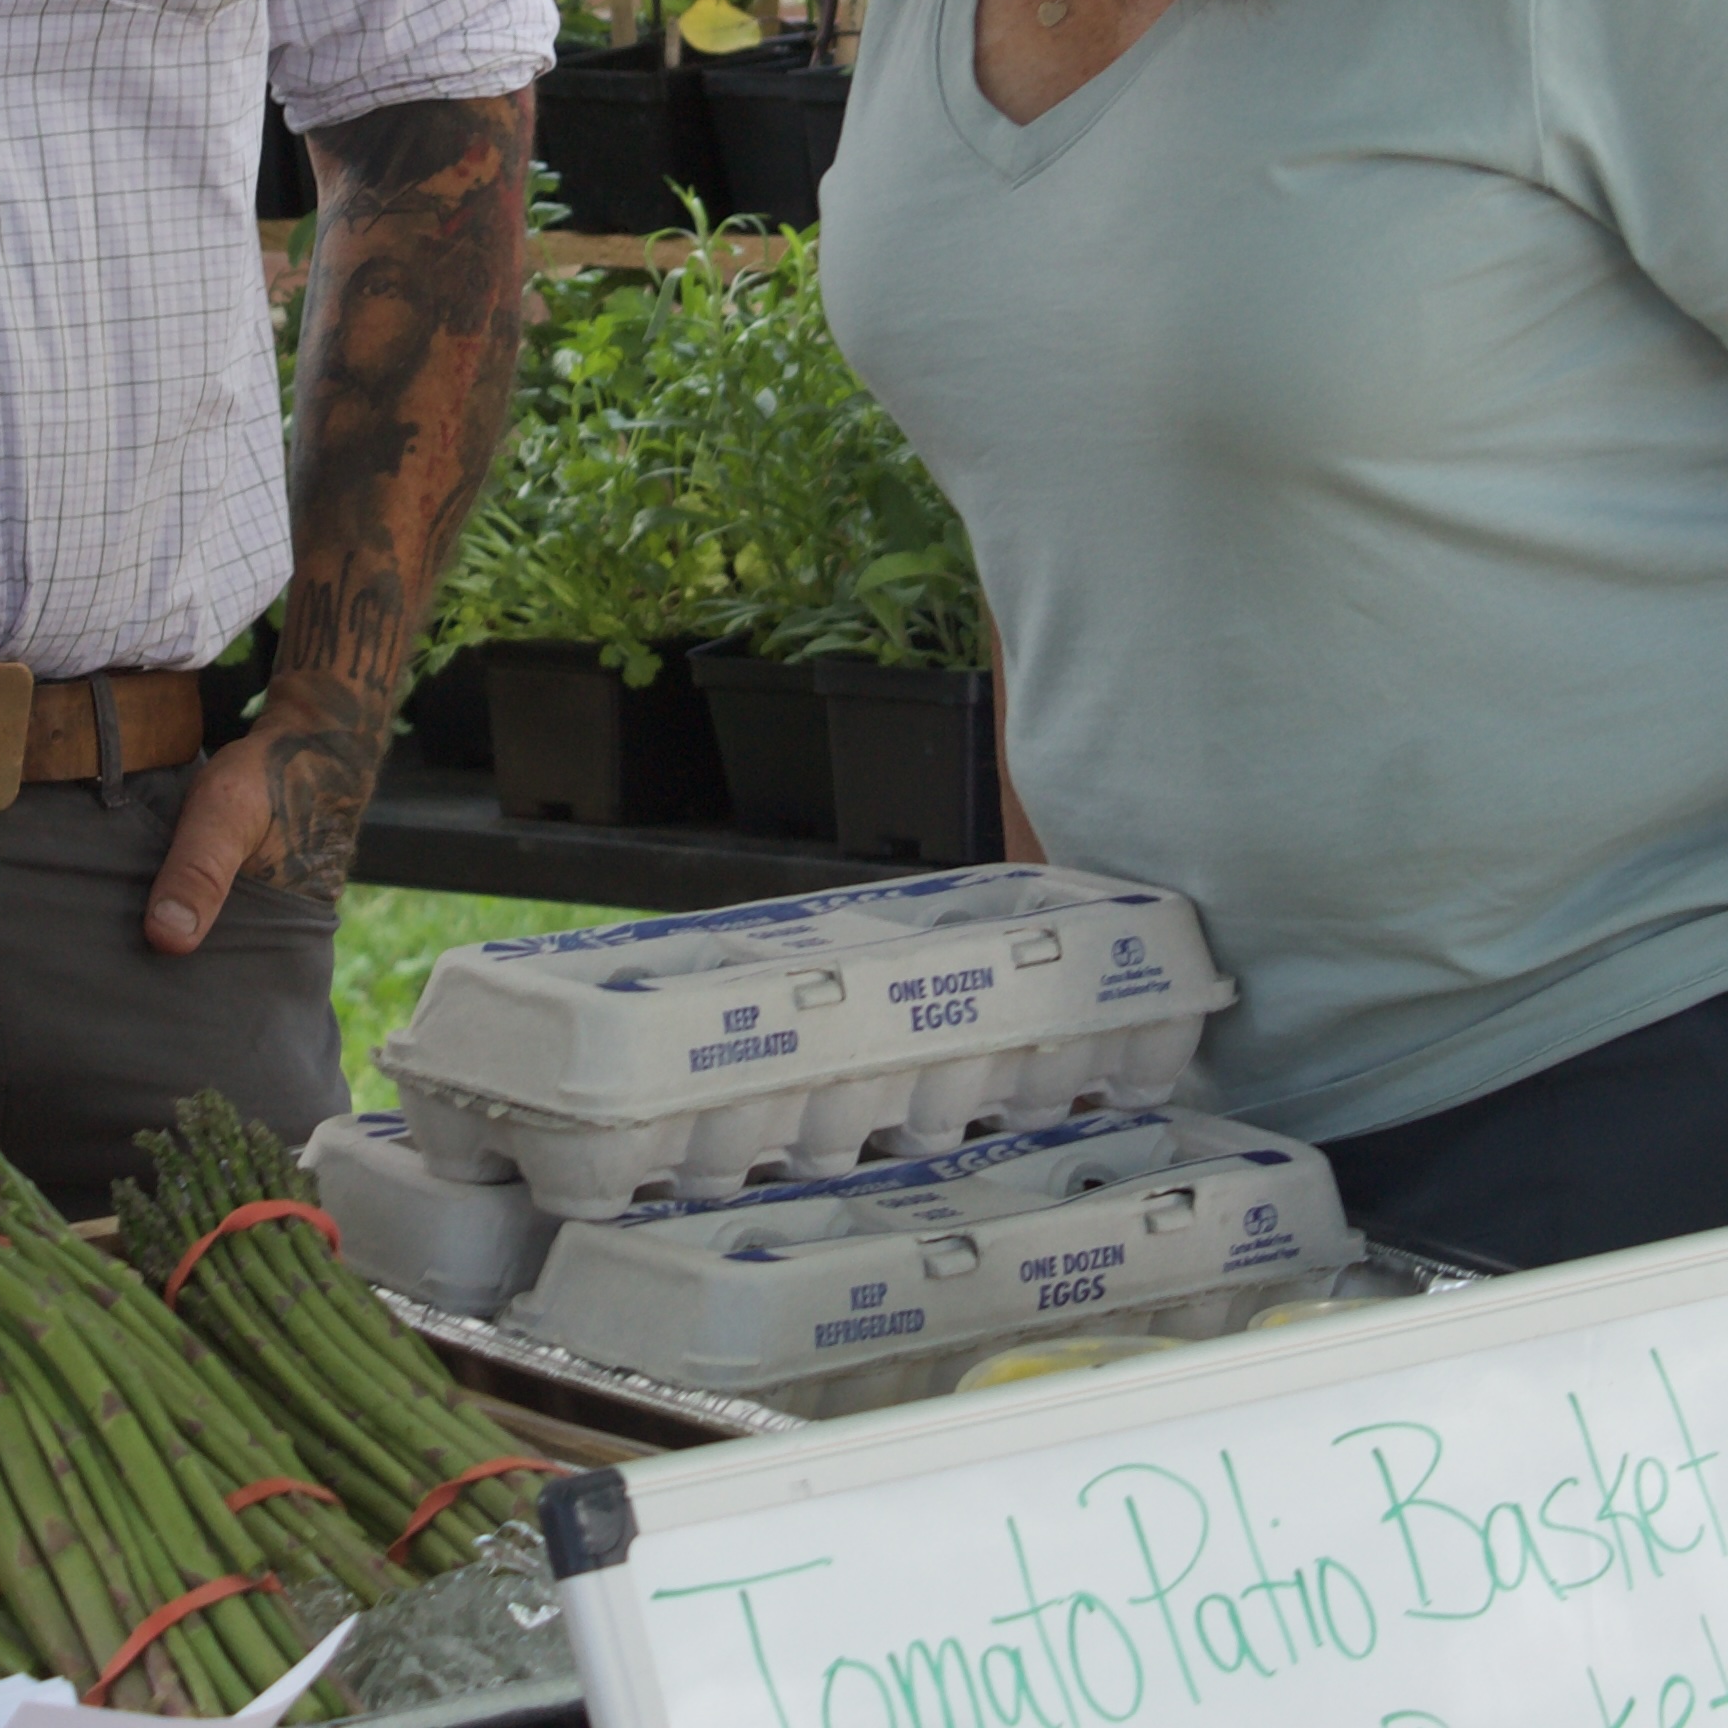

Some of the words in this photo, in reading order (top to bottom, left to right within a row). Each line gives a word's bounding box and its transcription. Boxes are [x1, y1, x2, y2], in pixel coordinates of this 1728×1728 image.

[888, 978, 928, 1005] ONE
[931, 966, 995, 998] DOZEN
[724, 1005, 760, 1035] KEEP
[911, 996, 979, 1033] EGGS
[689, 1029, 799, 1074] REFRIGERATED
[927, 1136, 1044, 1180] EGGS
[1019, 1256, 1059, 1284] ONE
[1063, 1243, 1126, 1276] DOZEN
[850, 1282, 888, 1312] KEEP
[1037, 1275, 1107, 1312] EGGS
[814, 1308, 925, 1350] REFRIGERATED
[651, 1515, 1144, 1728] Tomato
[1077, 1448, 1378, 1706] Patio
[1332, 1347, 1728, 1620] Basket
